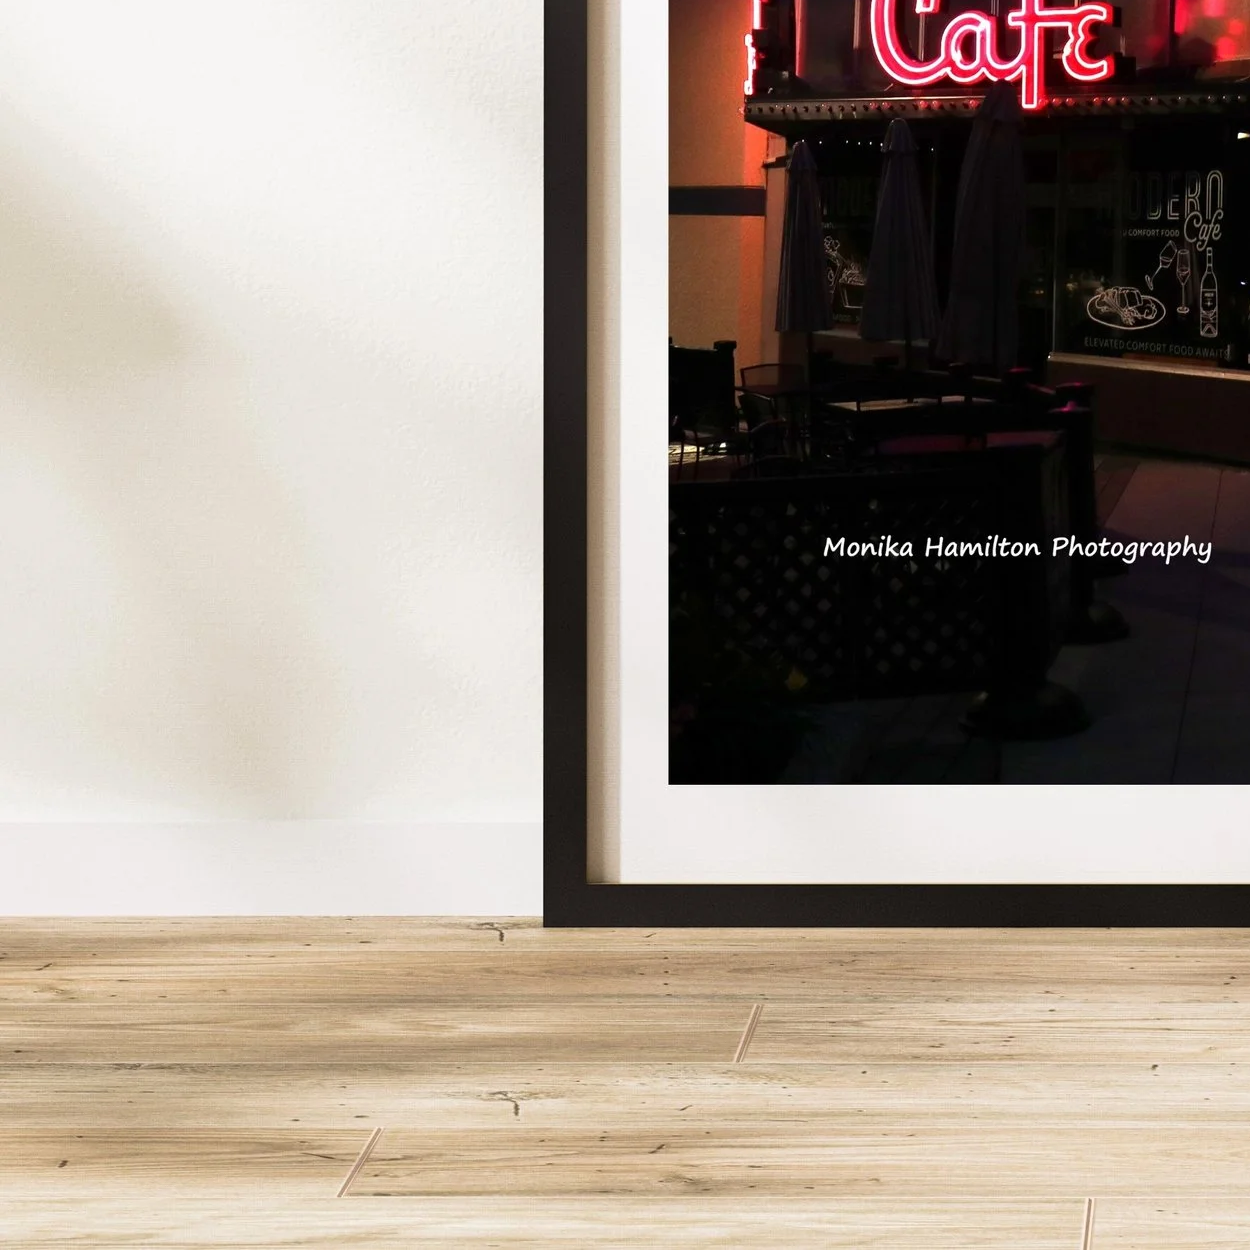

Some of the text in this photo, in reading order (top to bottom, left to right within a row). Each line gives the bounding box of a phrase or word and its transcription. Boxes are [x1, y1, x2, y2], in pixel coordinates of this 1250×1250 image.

[1127, 228, 1160, 237] COMFORT
[1161, 229, 1180, 238] FOOD
[1183, 209, 1224, 251] Cafe
[1084, 336, 1125, 350] ELEVATED
[1126, 341, 1168, 354] COMFORT
[1169, 344, 1194, 357] FOOD
